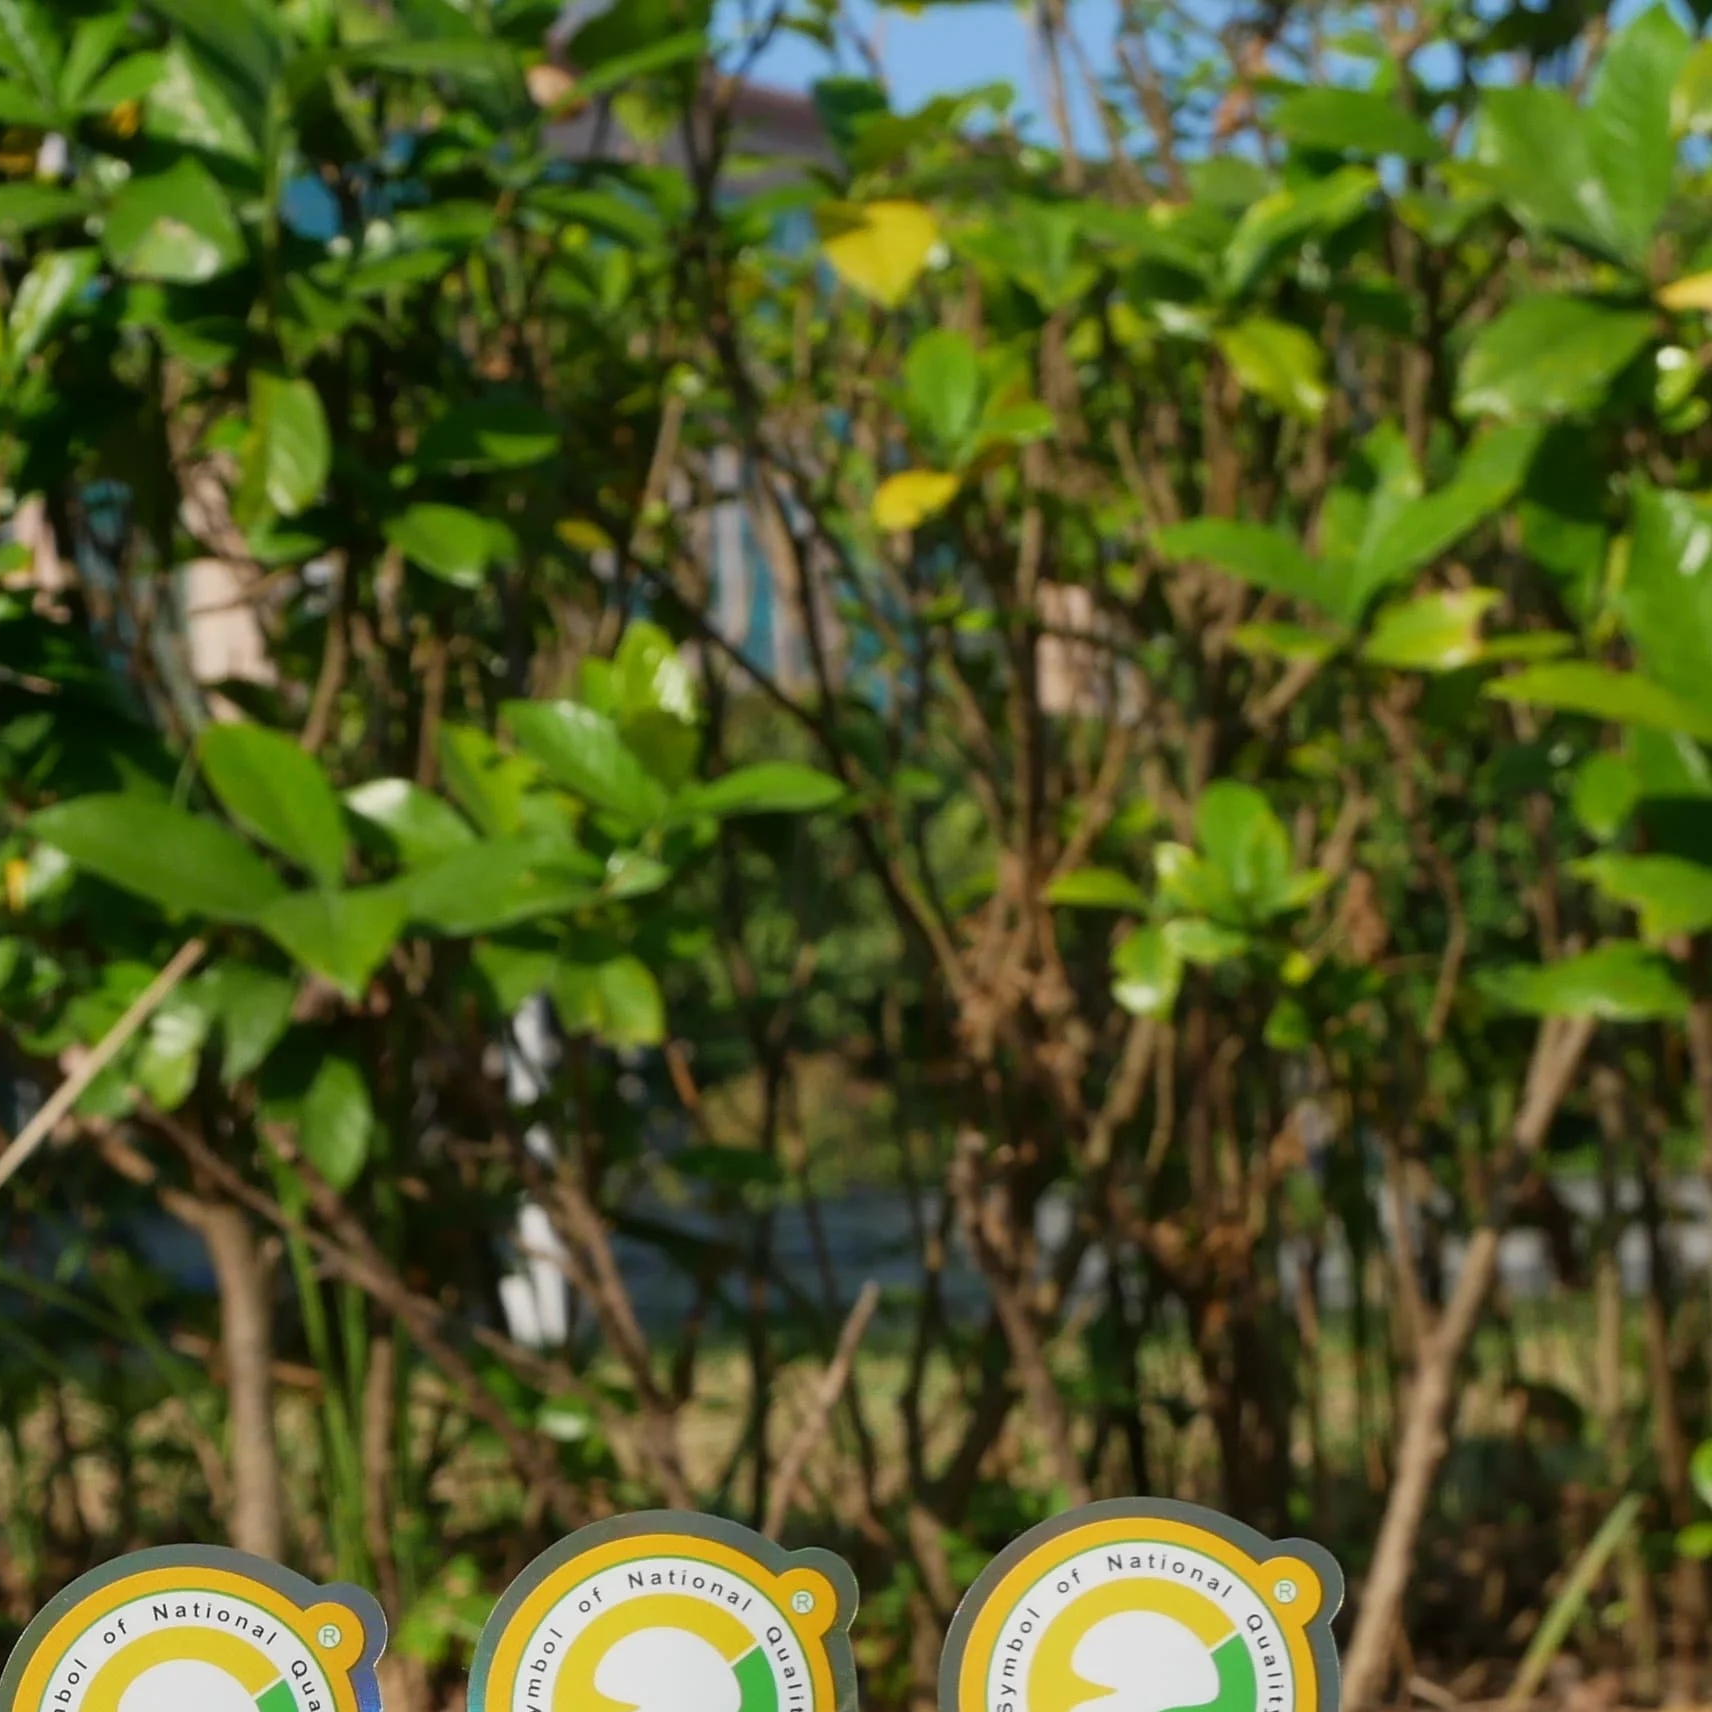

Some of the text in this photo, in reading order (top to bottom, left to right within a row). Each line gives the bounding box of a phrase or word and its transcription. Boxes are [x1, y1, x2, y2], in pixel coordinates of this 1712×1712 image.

[578, 1587, 603, 1613] of
[628, 1571, 753, 1611] National
[1057, 1567, 1082, 1594] of
[1107, 1555, 1233, 1598] National
[104, 1619, 127, 1645] of
[153, 1603, 277, 1646] National
